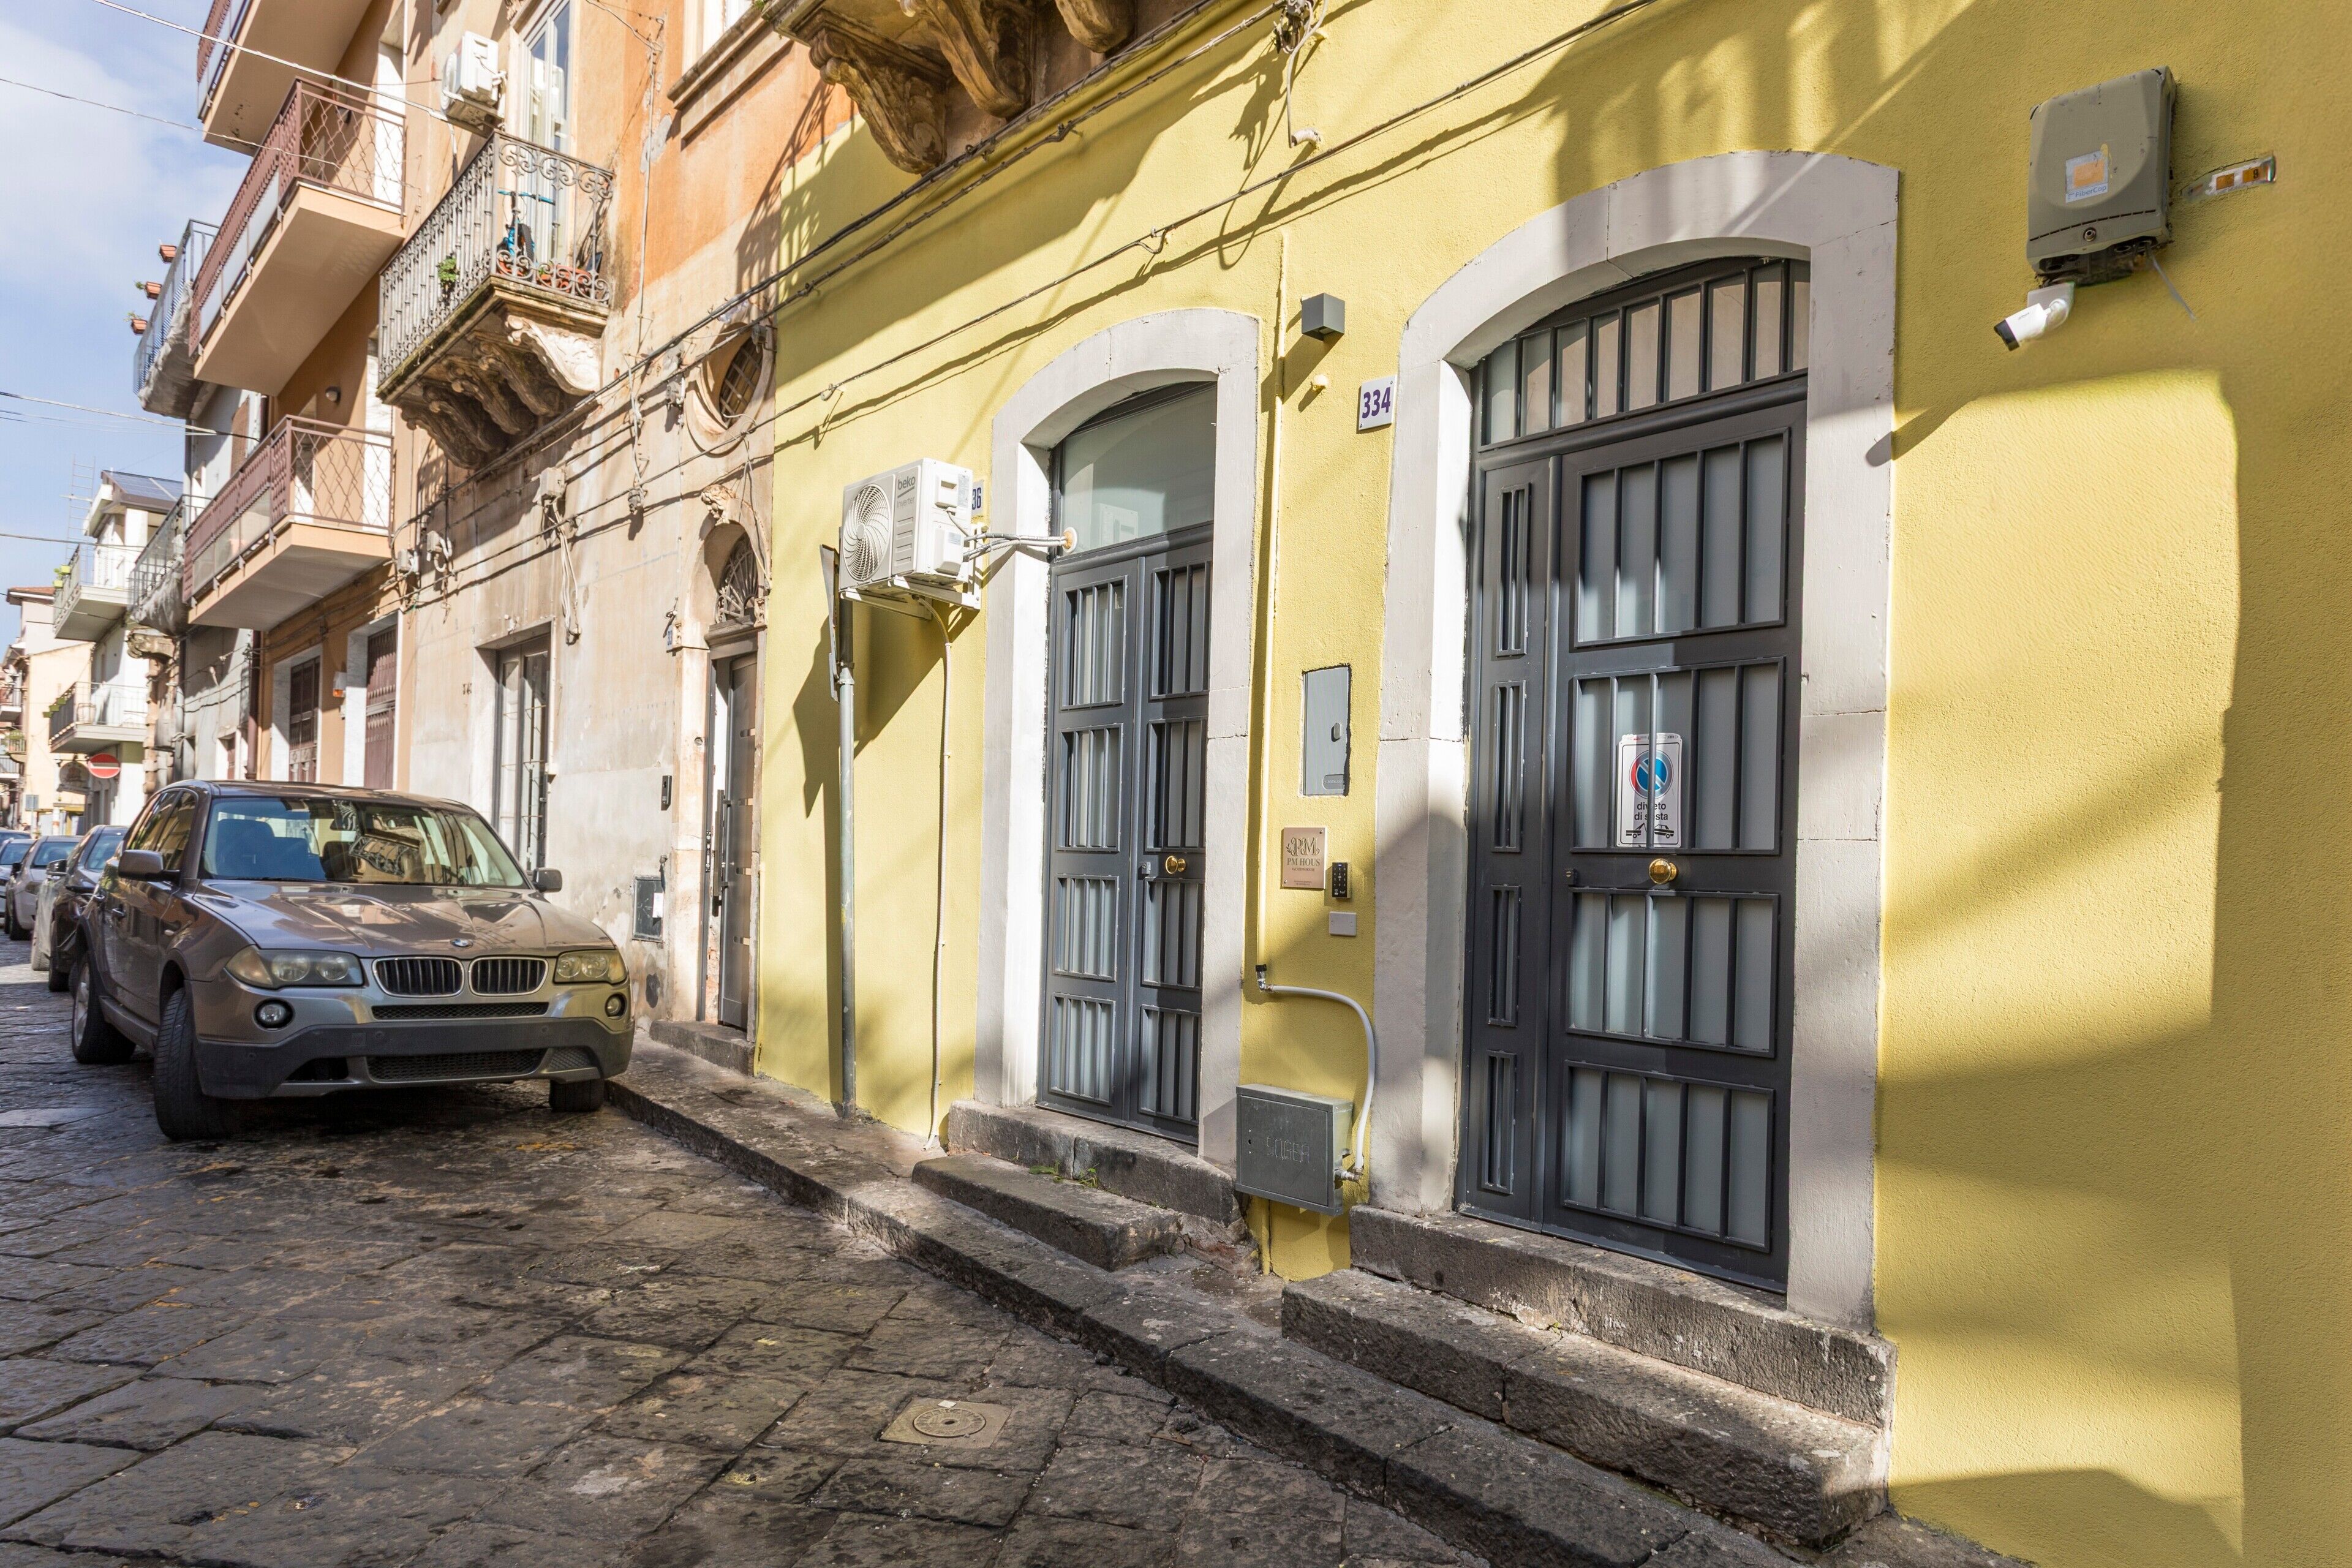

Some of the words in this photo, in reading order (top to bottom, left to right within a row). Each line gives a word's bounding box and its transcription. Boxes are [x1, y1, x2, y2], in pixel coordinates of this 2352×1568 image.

[2075, 186, 2106, 198] FiberCop
[1362, 386, 1391, 419] 334
[897, 476, 916, 490] beko
[1291, 837, 1320, 856] PM
[1300, 858, 1320, 866] HOUS
